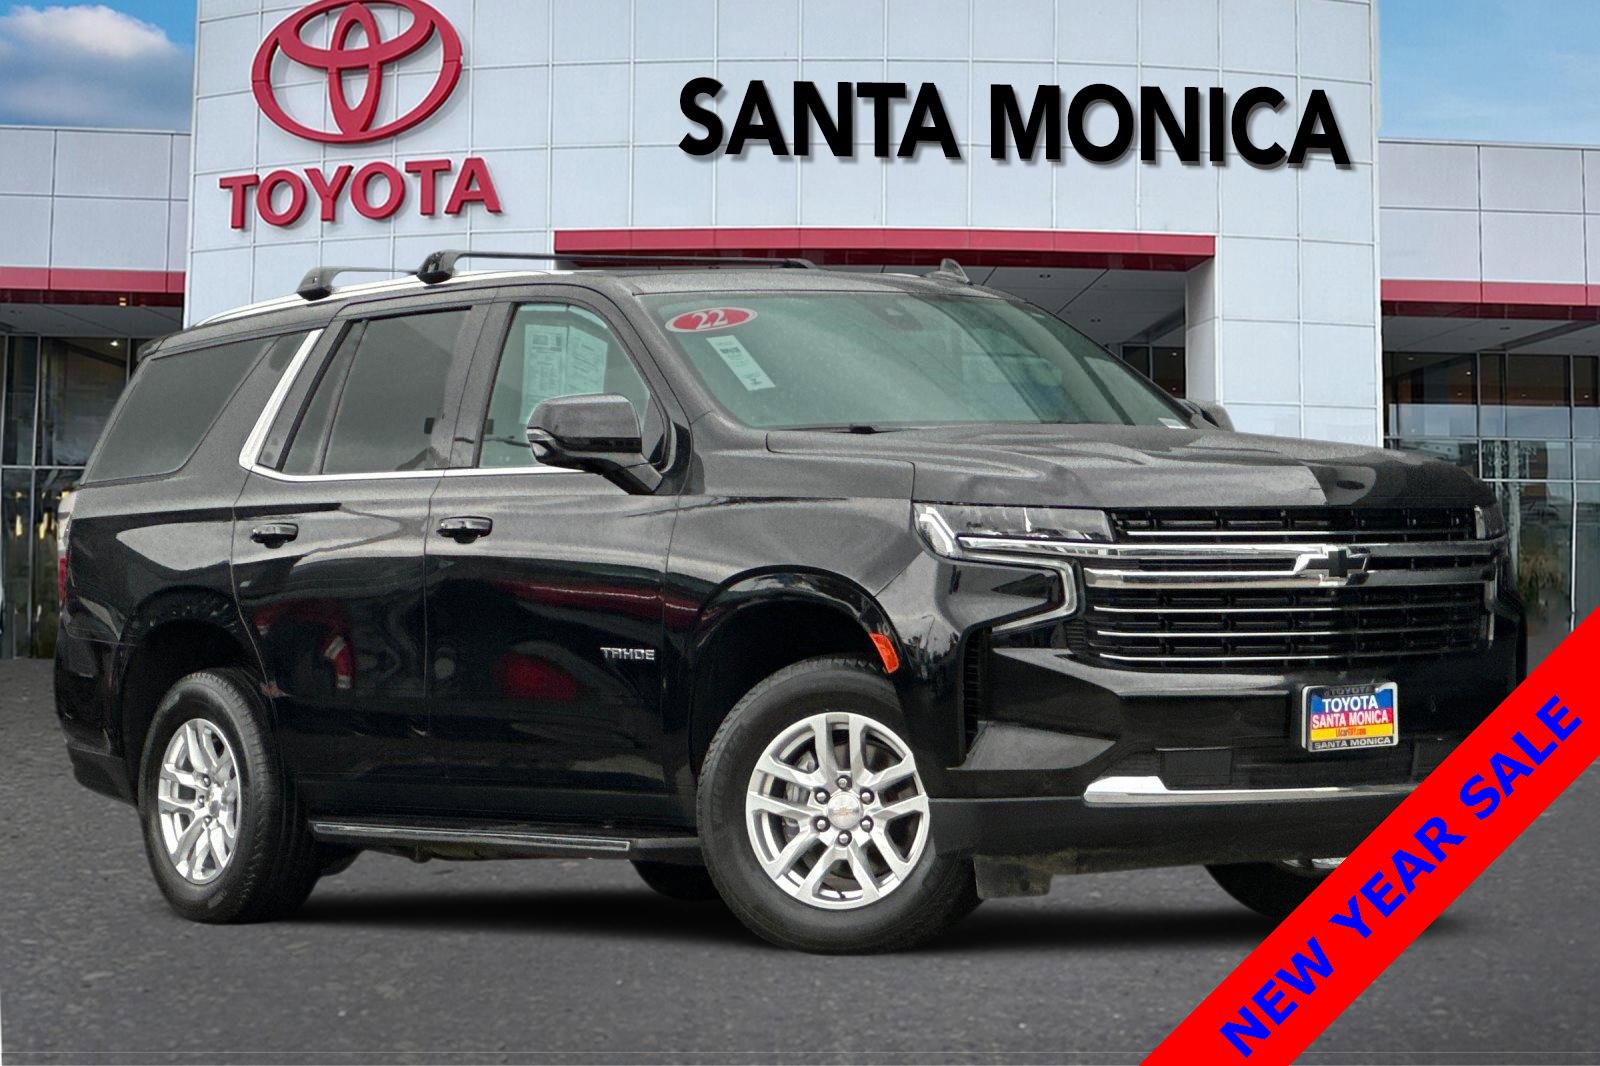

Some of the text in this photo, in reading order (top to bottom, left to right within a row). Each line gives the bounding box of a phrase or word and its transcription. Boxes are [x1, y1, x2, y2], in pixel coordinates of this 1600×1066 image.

[678, 77, 1352, 167] SANTA MONICA
[219, 157, 503, 230] TOYOTA
[692, 308, 729, 330] 22
[600, 646, 655, 661] TAHOE
[1321, 694, 1379, 713] TOYOTA
[1312, 709, 1389, 729] SANTA MONICA
[1314, 736, 1391, 749] SANTA MONICA
